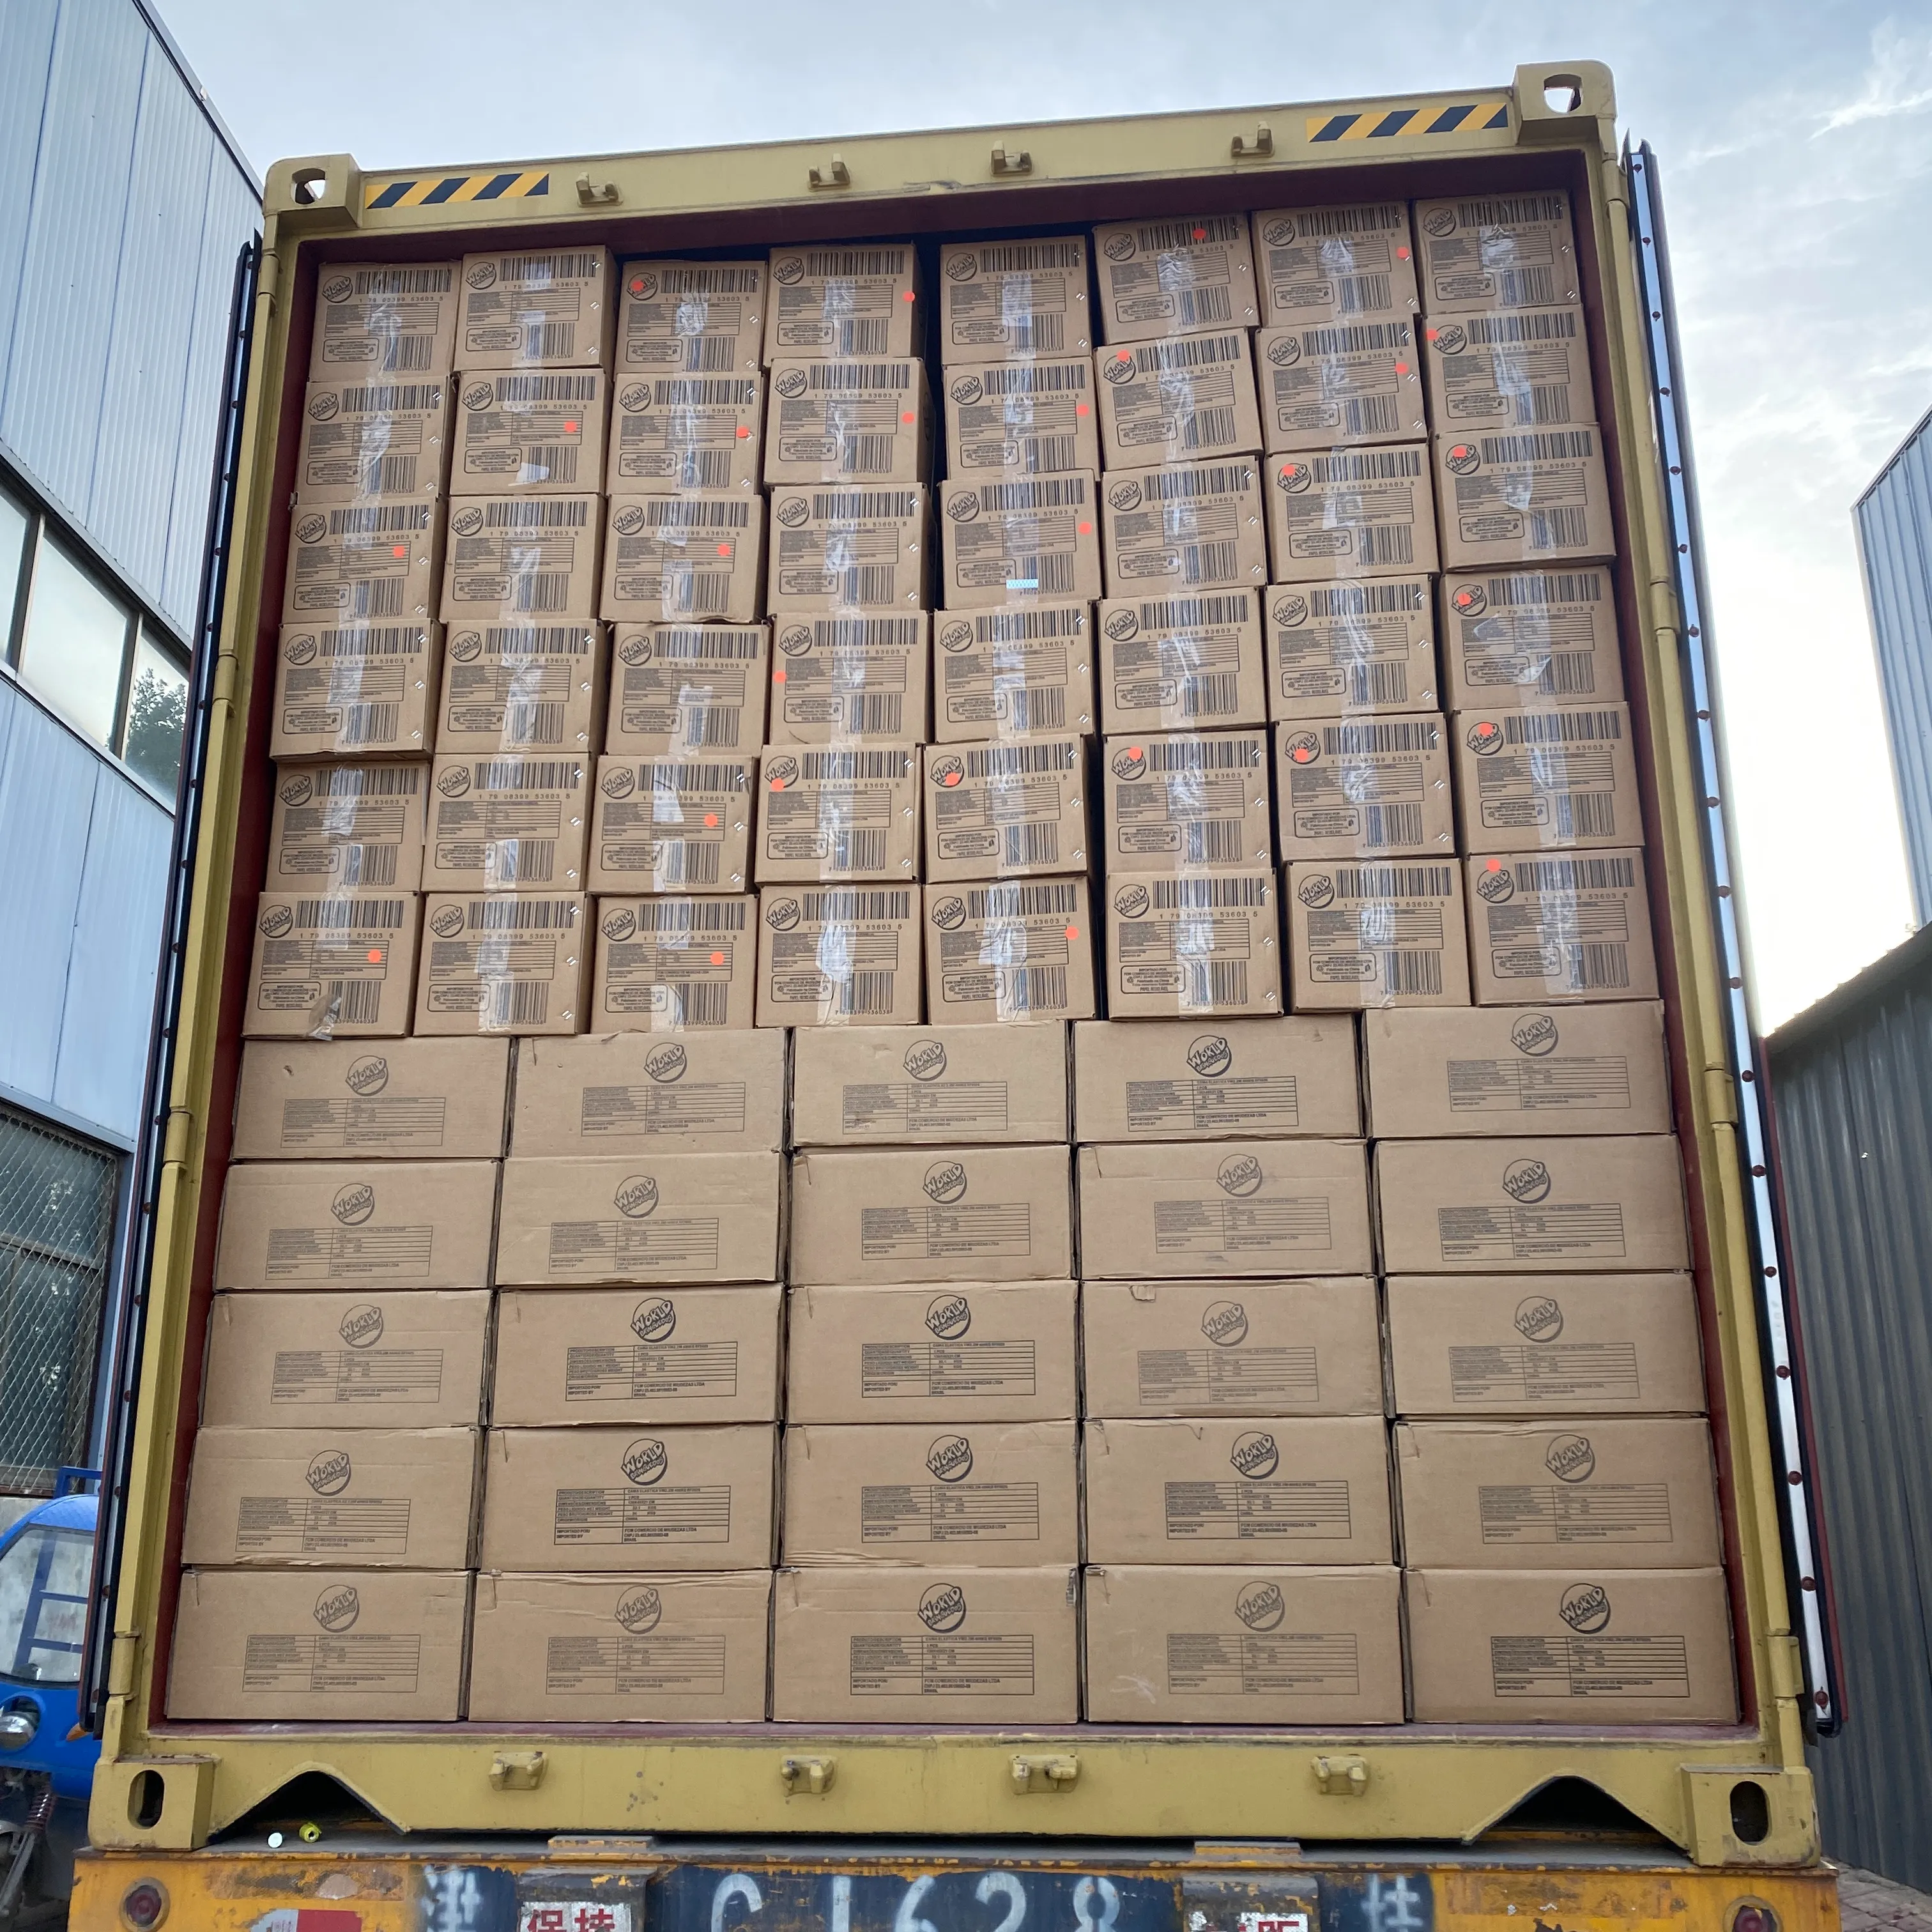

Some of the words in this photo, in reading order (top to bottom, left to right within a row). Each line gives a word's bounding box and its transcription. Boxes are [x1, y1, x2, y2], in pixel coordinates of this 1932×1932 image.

[1268, 337, 1297, 361] WORLD
[1433, 326, 1463, 349] WORLD
[461, 383, 491, 405] WORLD
[775, 371, 805, 392] WORLD
[951, 377, 979, 400] WORLD
[308, 393, 337, 415] WORLD
[619, 385, 649, 406] WORLD
[947, 493, 976, 516] WORLD
[1108, 481, 1138, 506] WORLD
[451, 508, 481, 530] WORLD
[612, 507, 642, 529] WORLD
[777, 498, 808, 521] WORLD
[295, 515, 325, 538] WORLD
[1273, 596, 1305, 621] WORLD
[940, 622, 970, 647] WORLD
[1105, 611, 1135, 636] WORLD
[284, 636, 315, 659] WORLD
[448, 632, 480, 656] WORLD
[618, 637, 649, 659] WORLD
[779, 627, 809, 650] WORLD
[437, 767, 469, 791] WORLD
[601, 769, 633, 792] WORLD
[765, 758, 797, 781] WORLD
[279, 775, 311, 802] WORLD
[1298, 877, 1330, 902] WORLD
[1477, 870, 1510, 896] WORLD
[931, 898, 962, 924] WORLD
[1114, 885, 1146, 911] WORLD
[259, 907, 291, 931] WORLD
[430, 907, 463, 931] WORLD
[602, 910, 633, 935] WORLD
[766, 900, 797, 924] WORLD
[1511, 1015, 1554, 1047] WORLD
[644, 1044, 684, 1074] WORLD
[903, 1042, 944, 1072] WORLD
[1187, 1037, 1227, 1068] WORLD
[346, 1057, 387, 1087] WORLD
[923, 1163, 963, 1195] WORLD
[1216, 1156, 1258, 1188] WORLD
[1503, 1161, 1545, 1194] WORLD
[331, 1185, 372, 1216] WORLD
[614, 1177, 656, 1209] WORLD
[339, 1307, 381, 1338] WORLD
[631, 1300, 673, 1333] WORLD
[925, 1297, 967, 1330] WORLD
[1201, 1303, 1244, 1337] WORLD
[1514, 1298, 1558, 1333] WORLD
[621, 1441, 664, 1475] WORLD
[926, 1438, 969, 1472] WORLD
[1230, 1434, 1275, 1468] WORLD
[1545, 1437, 1590, 1472] WORLD
[305, 1453, 349, 1485] WORLD
[313, 1587, 357, 1621] WORLD
[615, 1588, 659, 1623] WORLD
[918, 1586, 963, 1622] WORLD
[1235, 1584, 1280, 1620] WORLD
[1560, 1586, 1606, 1622] WORLD
